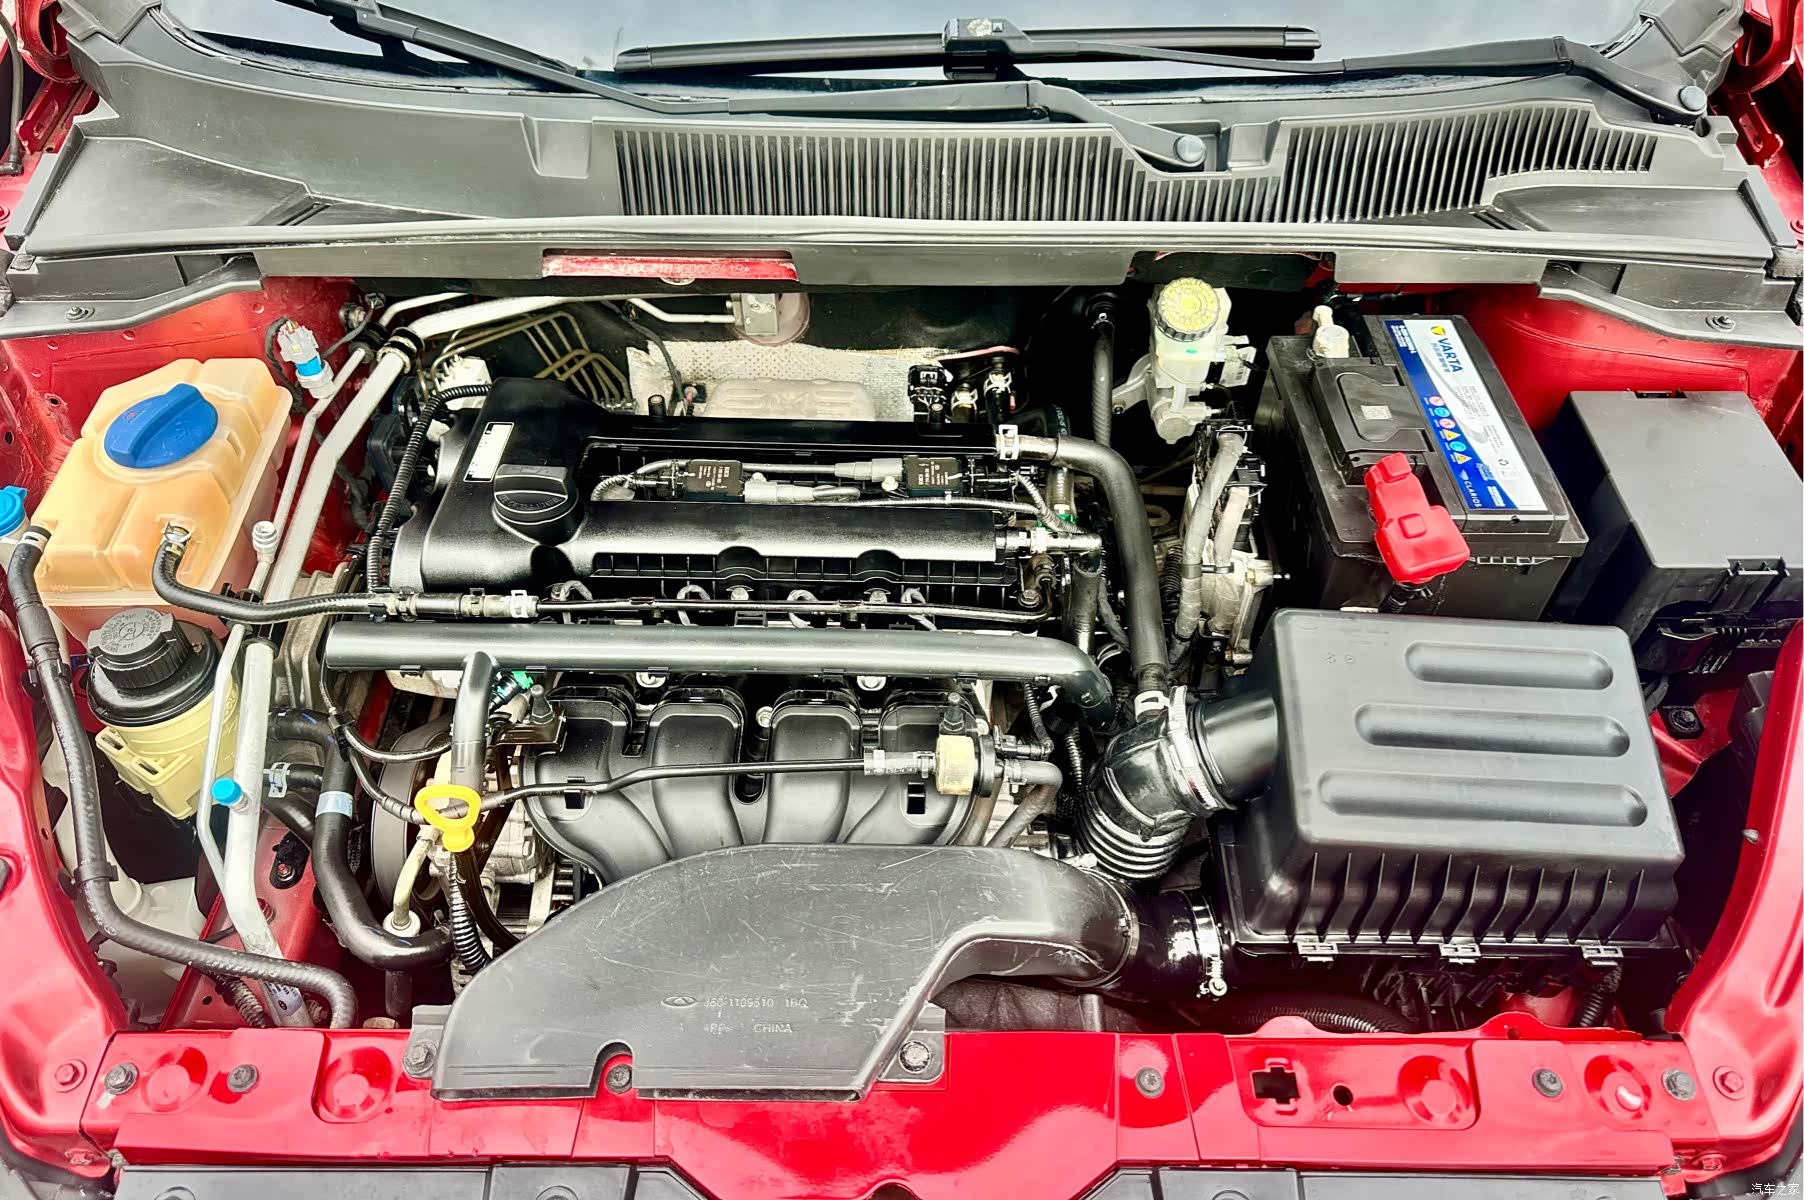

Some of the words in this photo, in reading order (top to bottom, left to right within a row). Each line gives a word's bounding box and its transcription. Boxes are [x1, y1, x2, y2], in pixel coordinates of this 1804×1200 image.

[1437, 337, 1464, 373] VARTA
[1463, 480, 1482, 507] CLARIOS
[753, 1023, 793, 1033] CHINA
